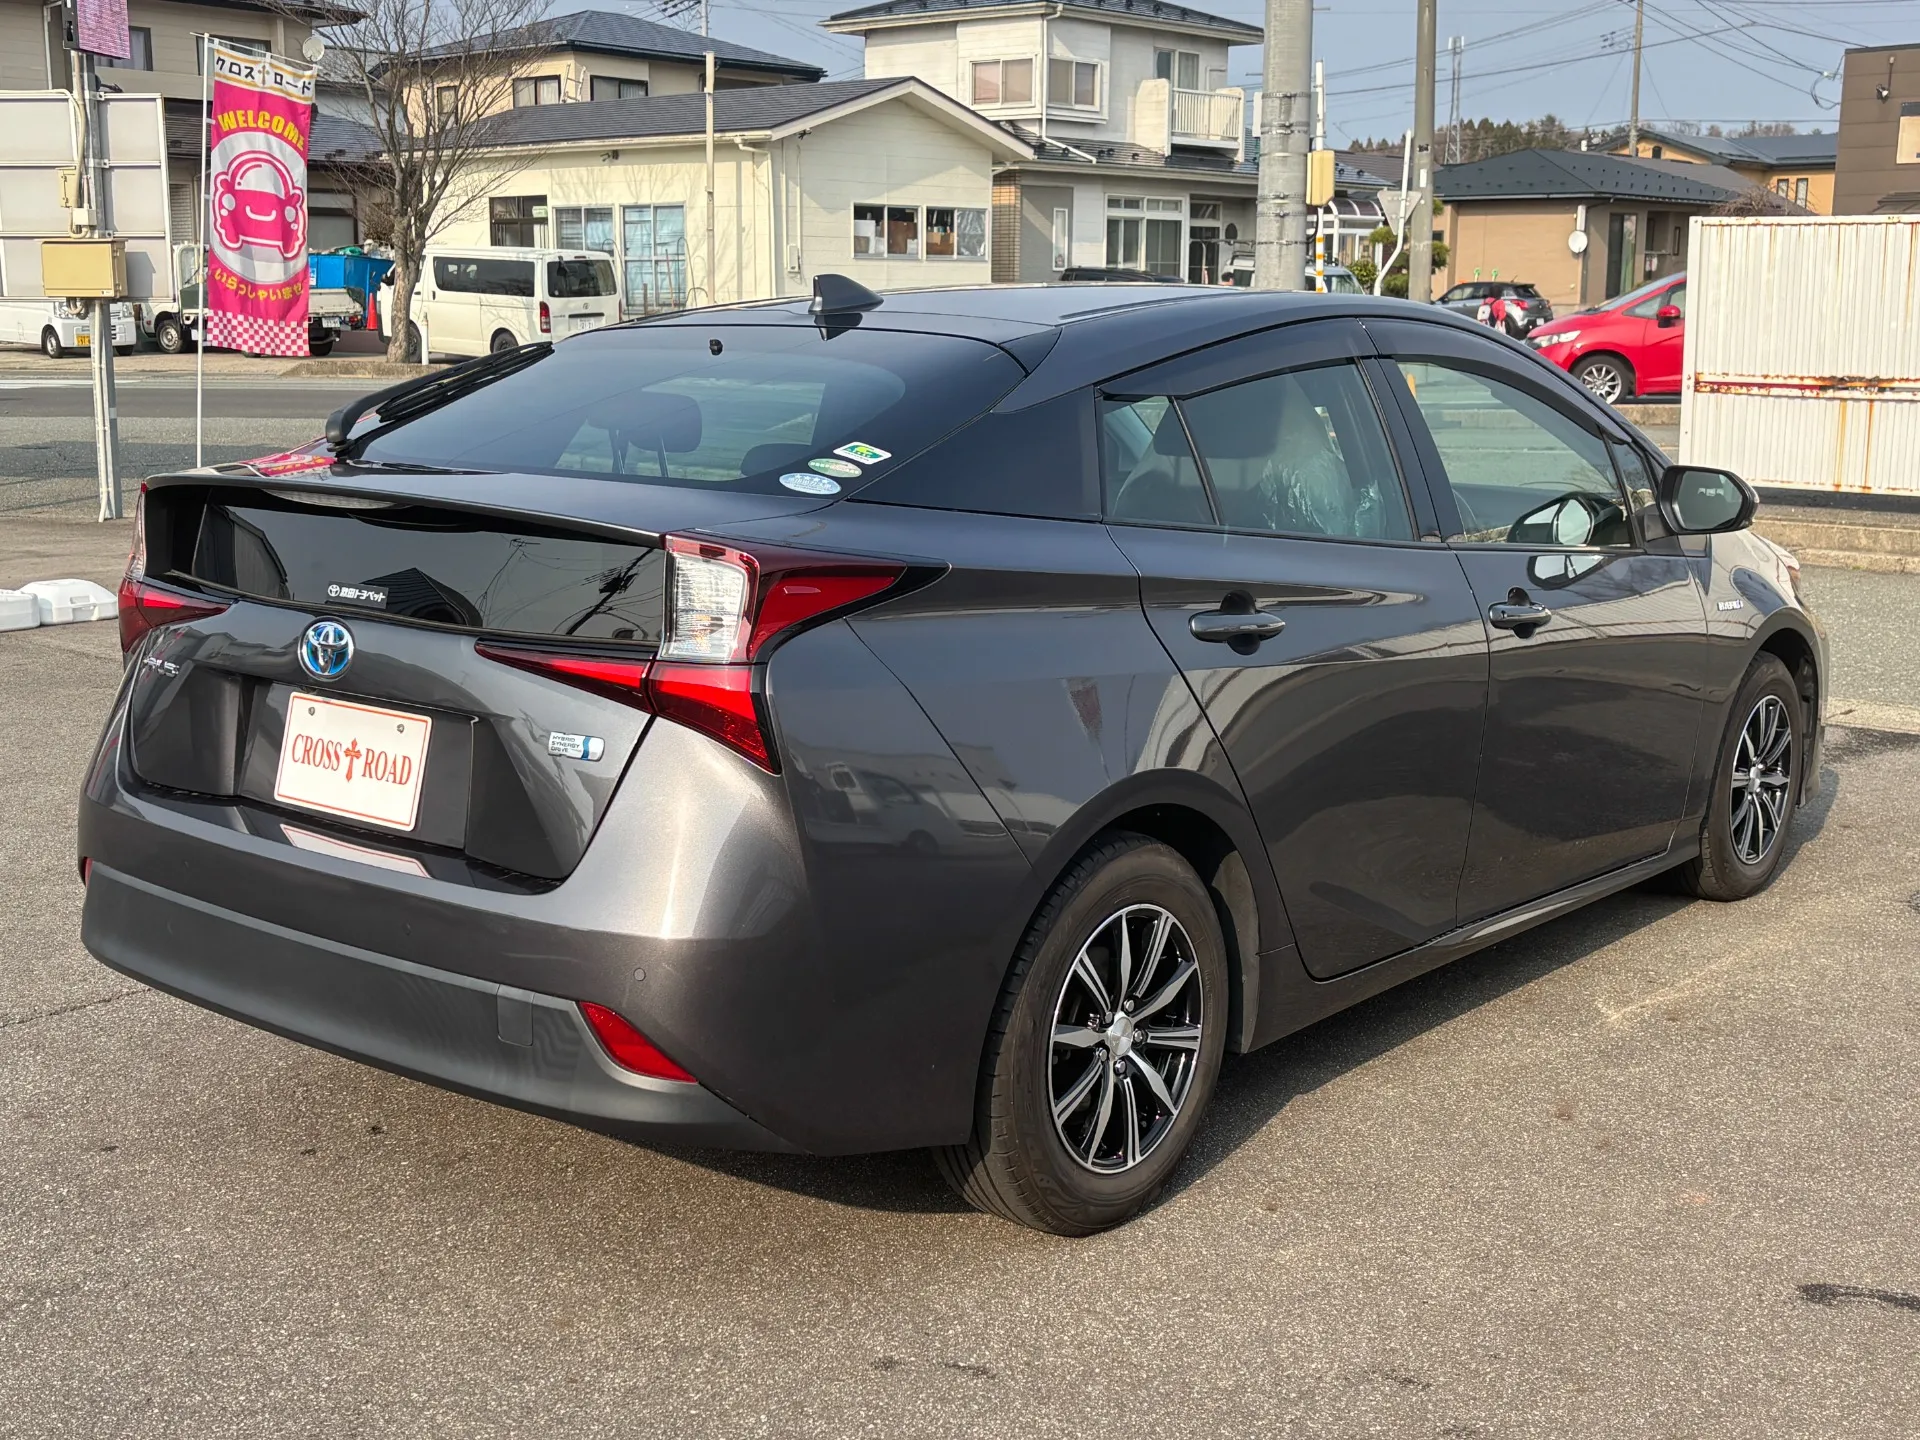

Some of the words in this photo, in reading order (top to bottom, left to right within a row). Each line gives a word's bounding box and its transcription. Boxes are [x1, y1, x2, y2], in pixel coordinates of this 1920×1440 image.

[216, 56, 256, 80] クロス
[274, 72, 311, 95] ロード
[217, 110, 304, 151] WELCOME
[214, 268, 303, 301] いらっしゃいませ
[291, 733, 342, 772] CROSS
[361, 747, 412, 786] ROAD
